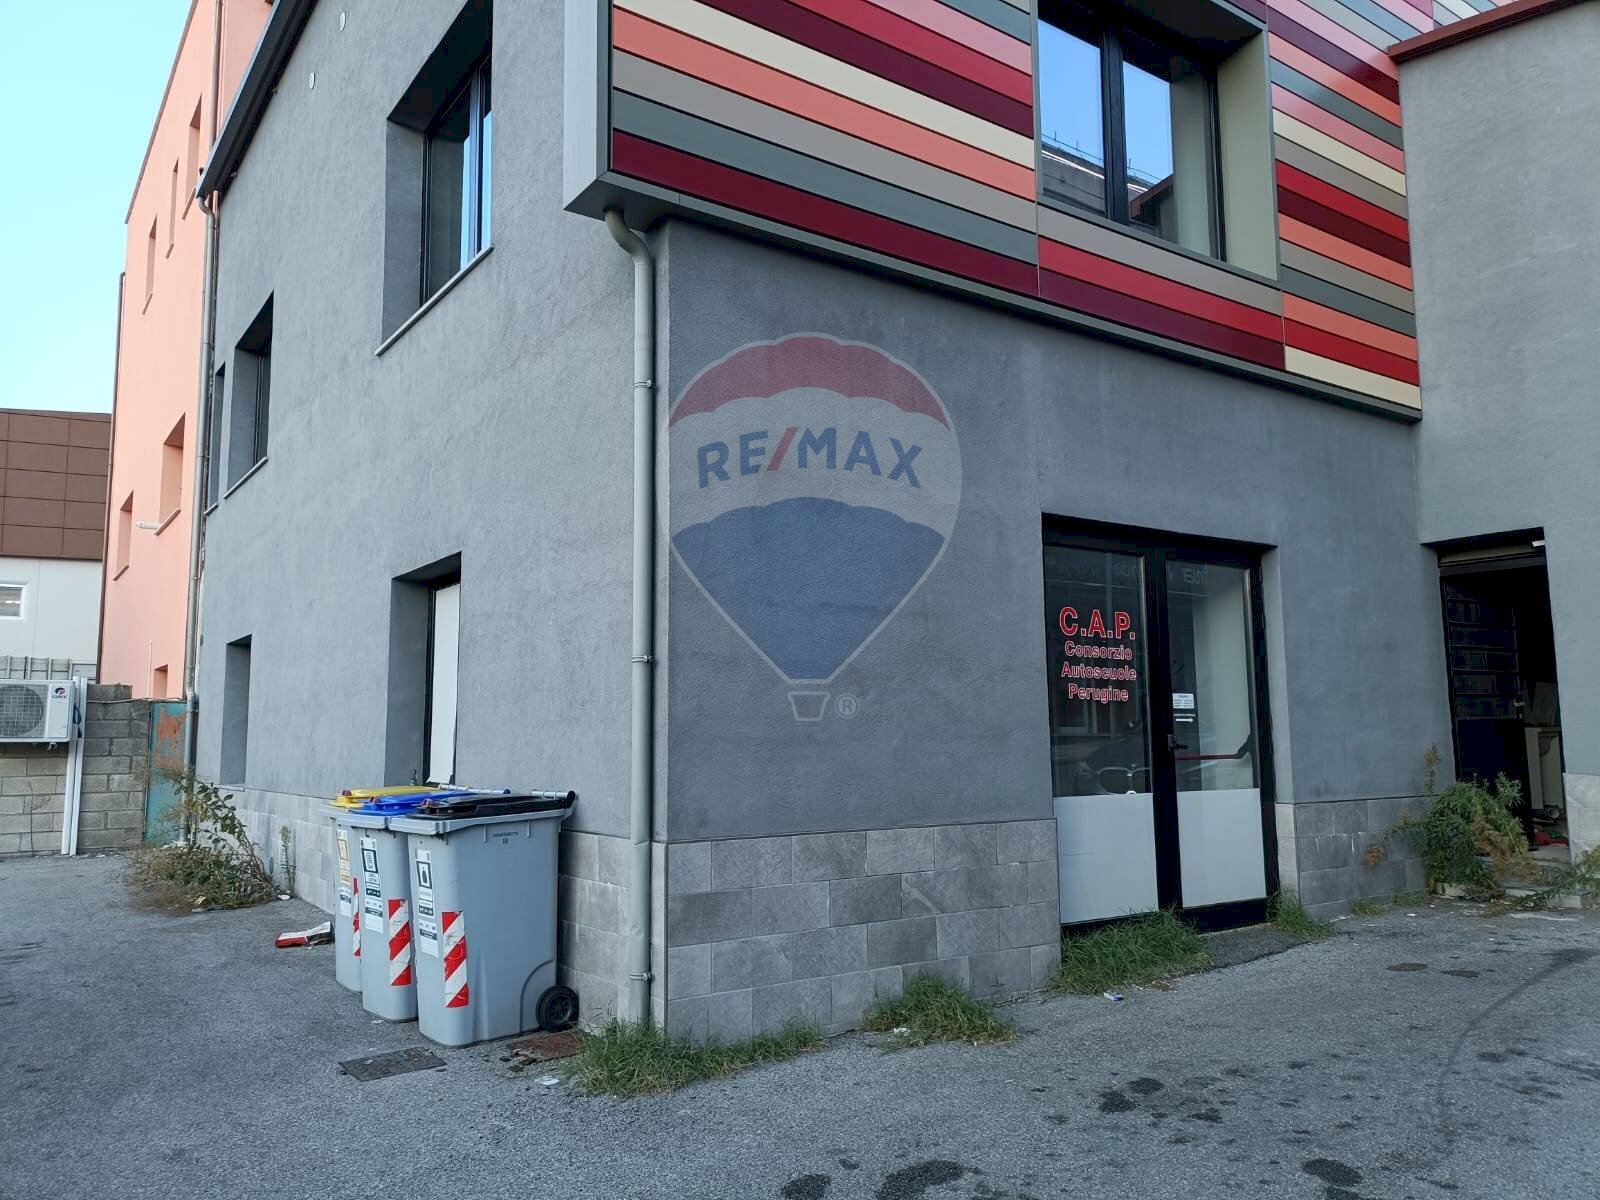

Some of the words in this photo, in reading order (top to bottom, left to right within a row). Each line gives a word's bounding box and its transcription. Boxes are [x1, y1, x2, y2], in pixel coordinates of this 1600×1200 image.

[1059, 606, 1136, 640] C.A.P.
[1064, 641, 1133, 661] Consorzio
[1061, 662, 1137, 681] Autoscuole
[1068, 683, 1129, 704] Perugine
